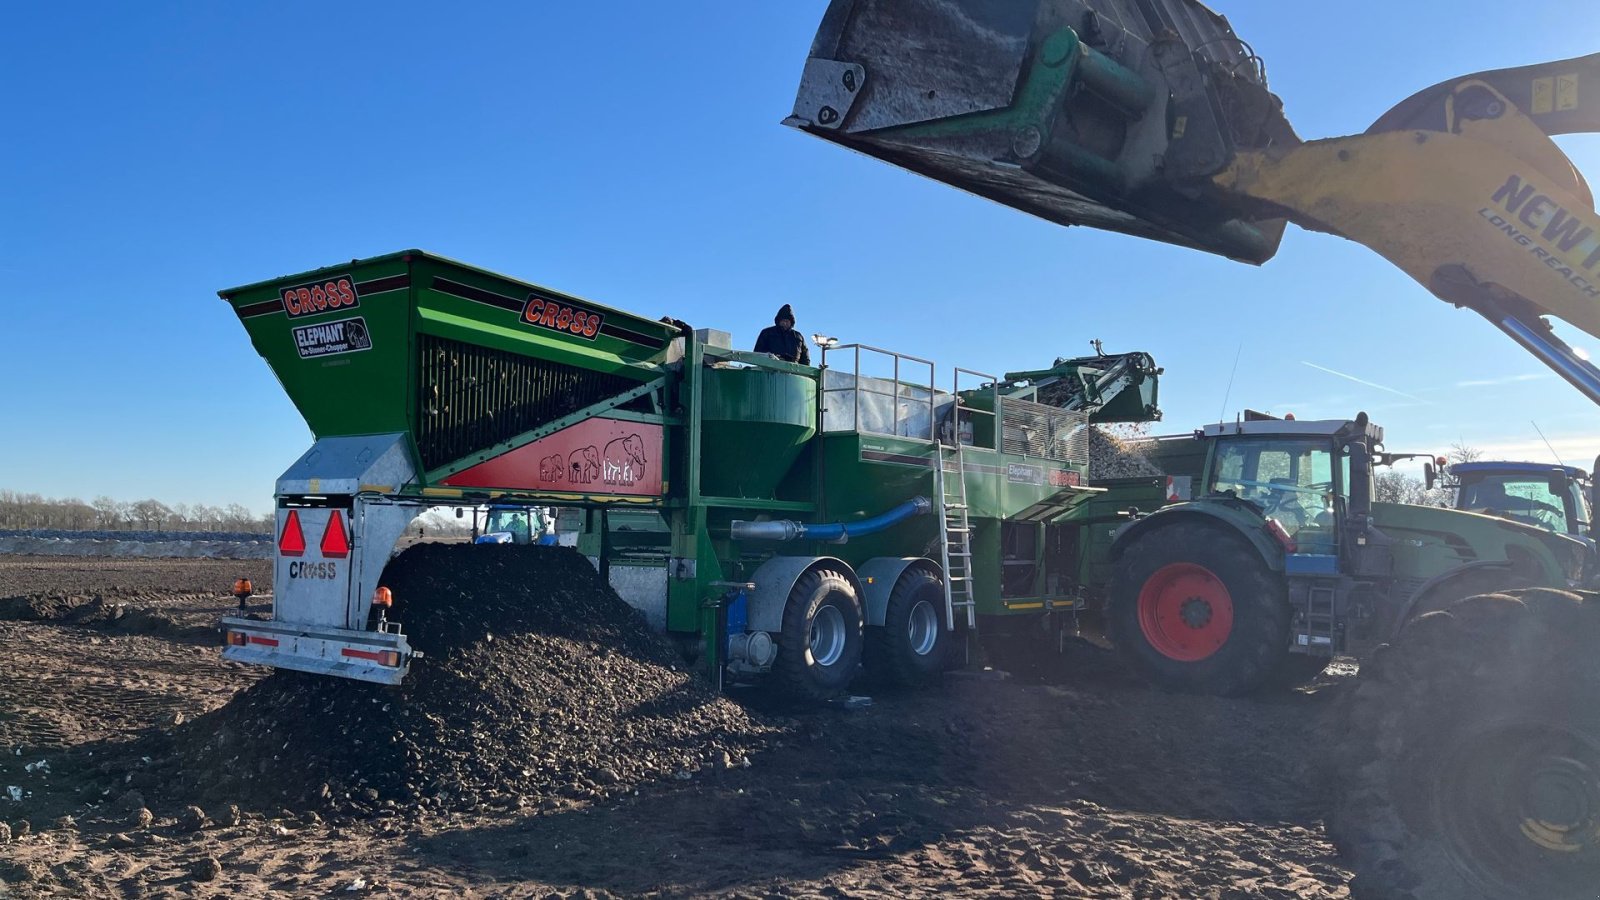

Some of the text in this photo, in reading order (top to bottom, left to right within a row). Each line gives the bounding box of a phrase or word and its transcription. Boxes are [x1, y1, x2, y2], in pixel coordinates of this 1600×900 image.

[1478, 208, 1532, 246] LONG
[1491, 174, 1593, 253] NEW
[284, 279, 354, 315] CROSS
[296, 323, 345, 347] ELEPHANT
[525, 298, 600, 337] CROSS
[289, 561, 336, 579] CROSS
